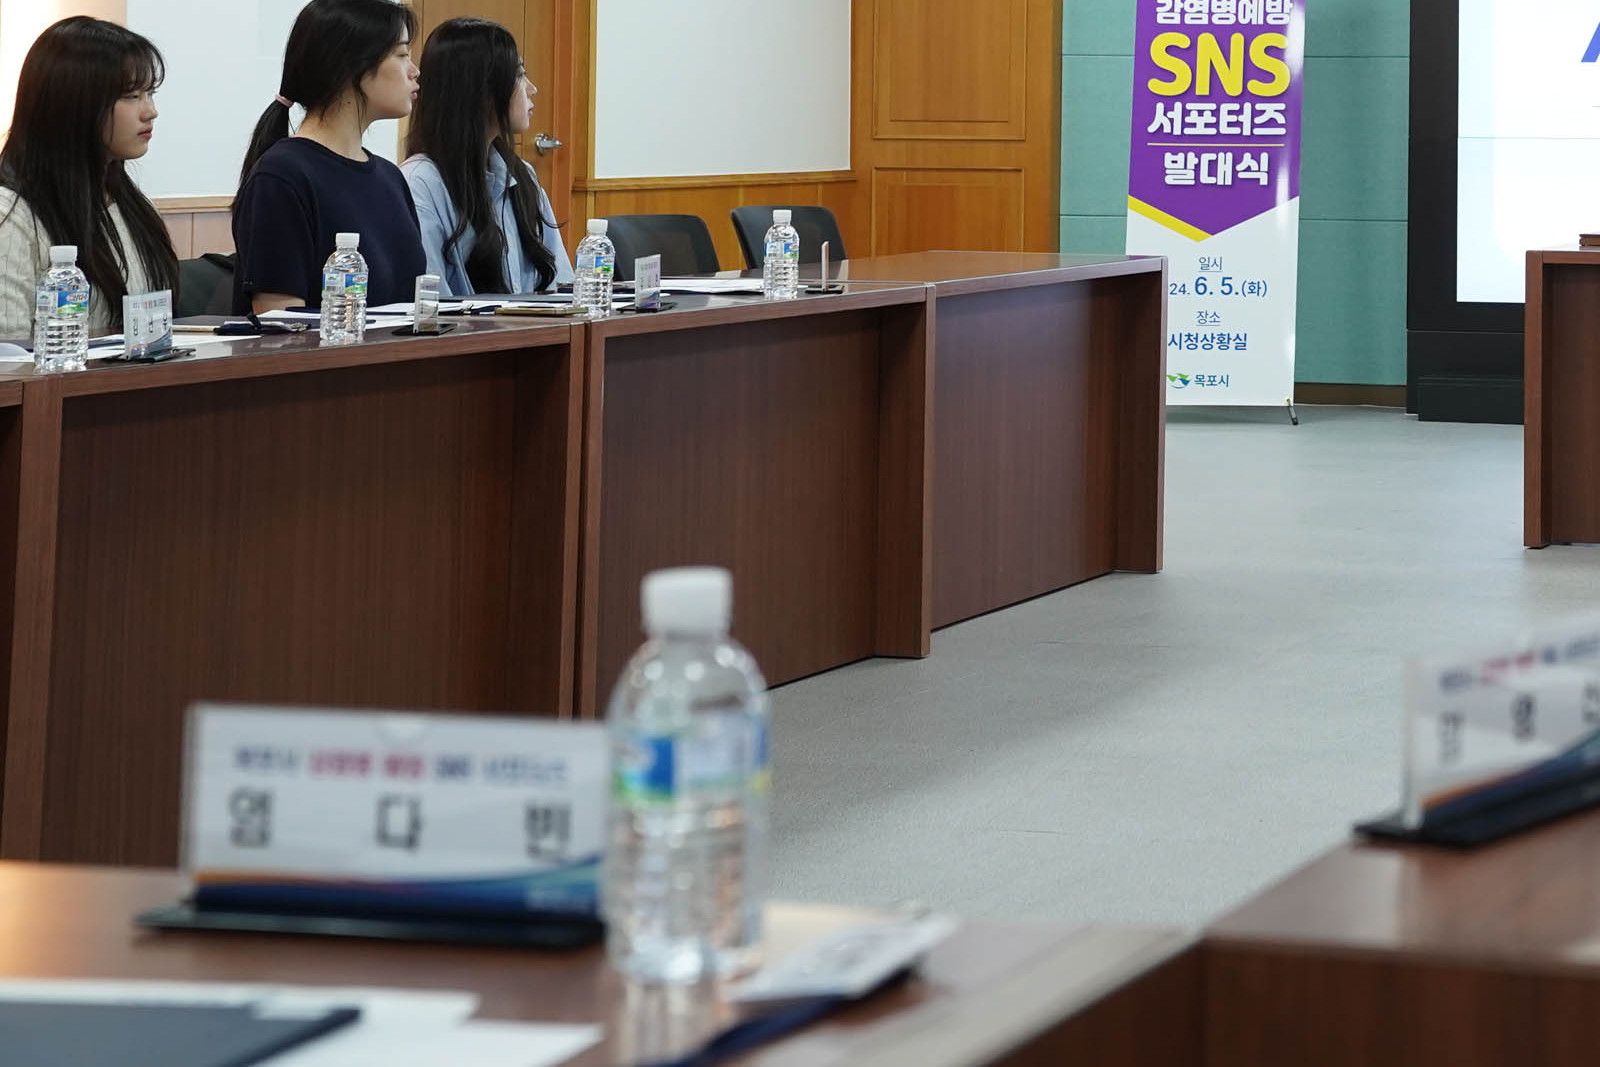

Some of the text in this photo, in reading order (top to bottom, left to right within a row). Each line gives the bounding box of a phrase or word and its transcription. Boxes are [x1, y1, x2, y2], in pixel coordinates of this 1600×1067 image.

[1147, 32, 1291, 97] SNS
[1147, 101, 1287, 136] 서포터즈
[1164, 152, 1269, 185] 발대식
[1198, 256, 1223, 270] 일시
[1169, 283, 1190, 295] 24.
[1196, 310, 1221, 324] 장소
[1168, 332, 1248, 351] 시청상황실
[1194, 374, 1229, 387] 목포시
